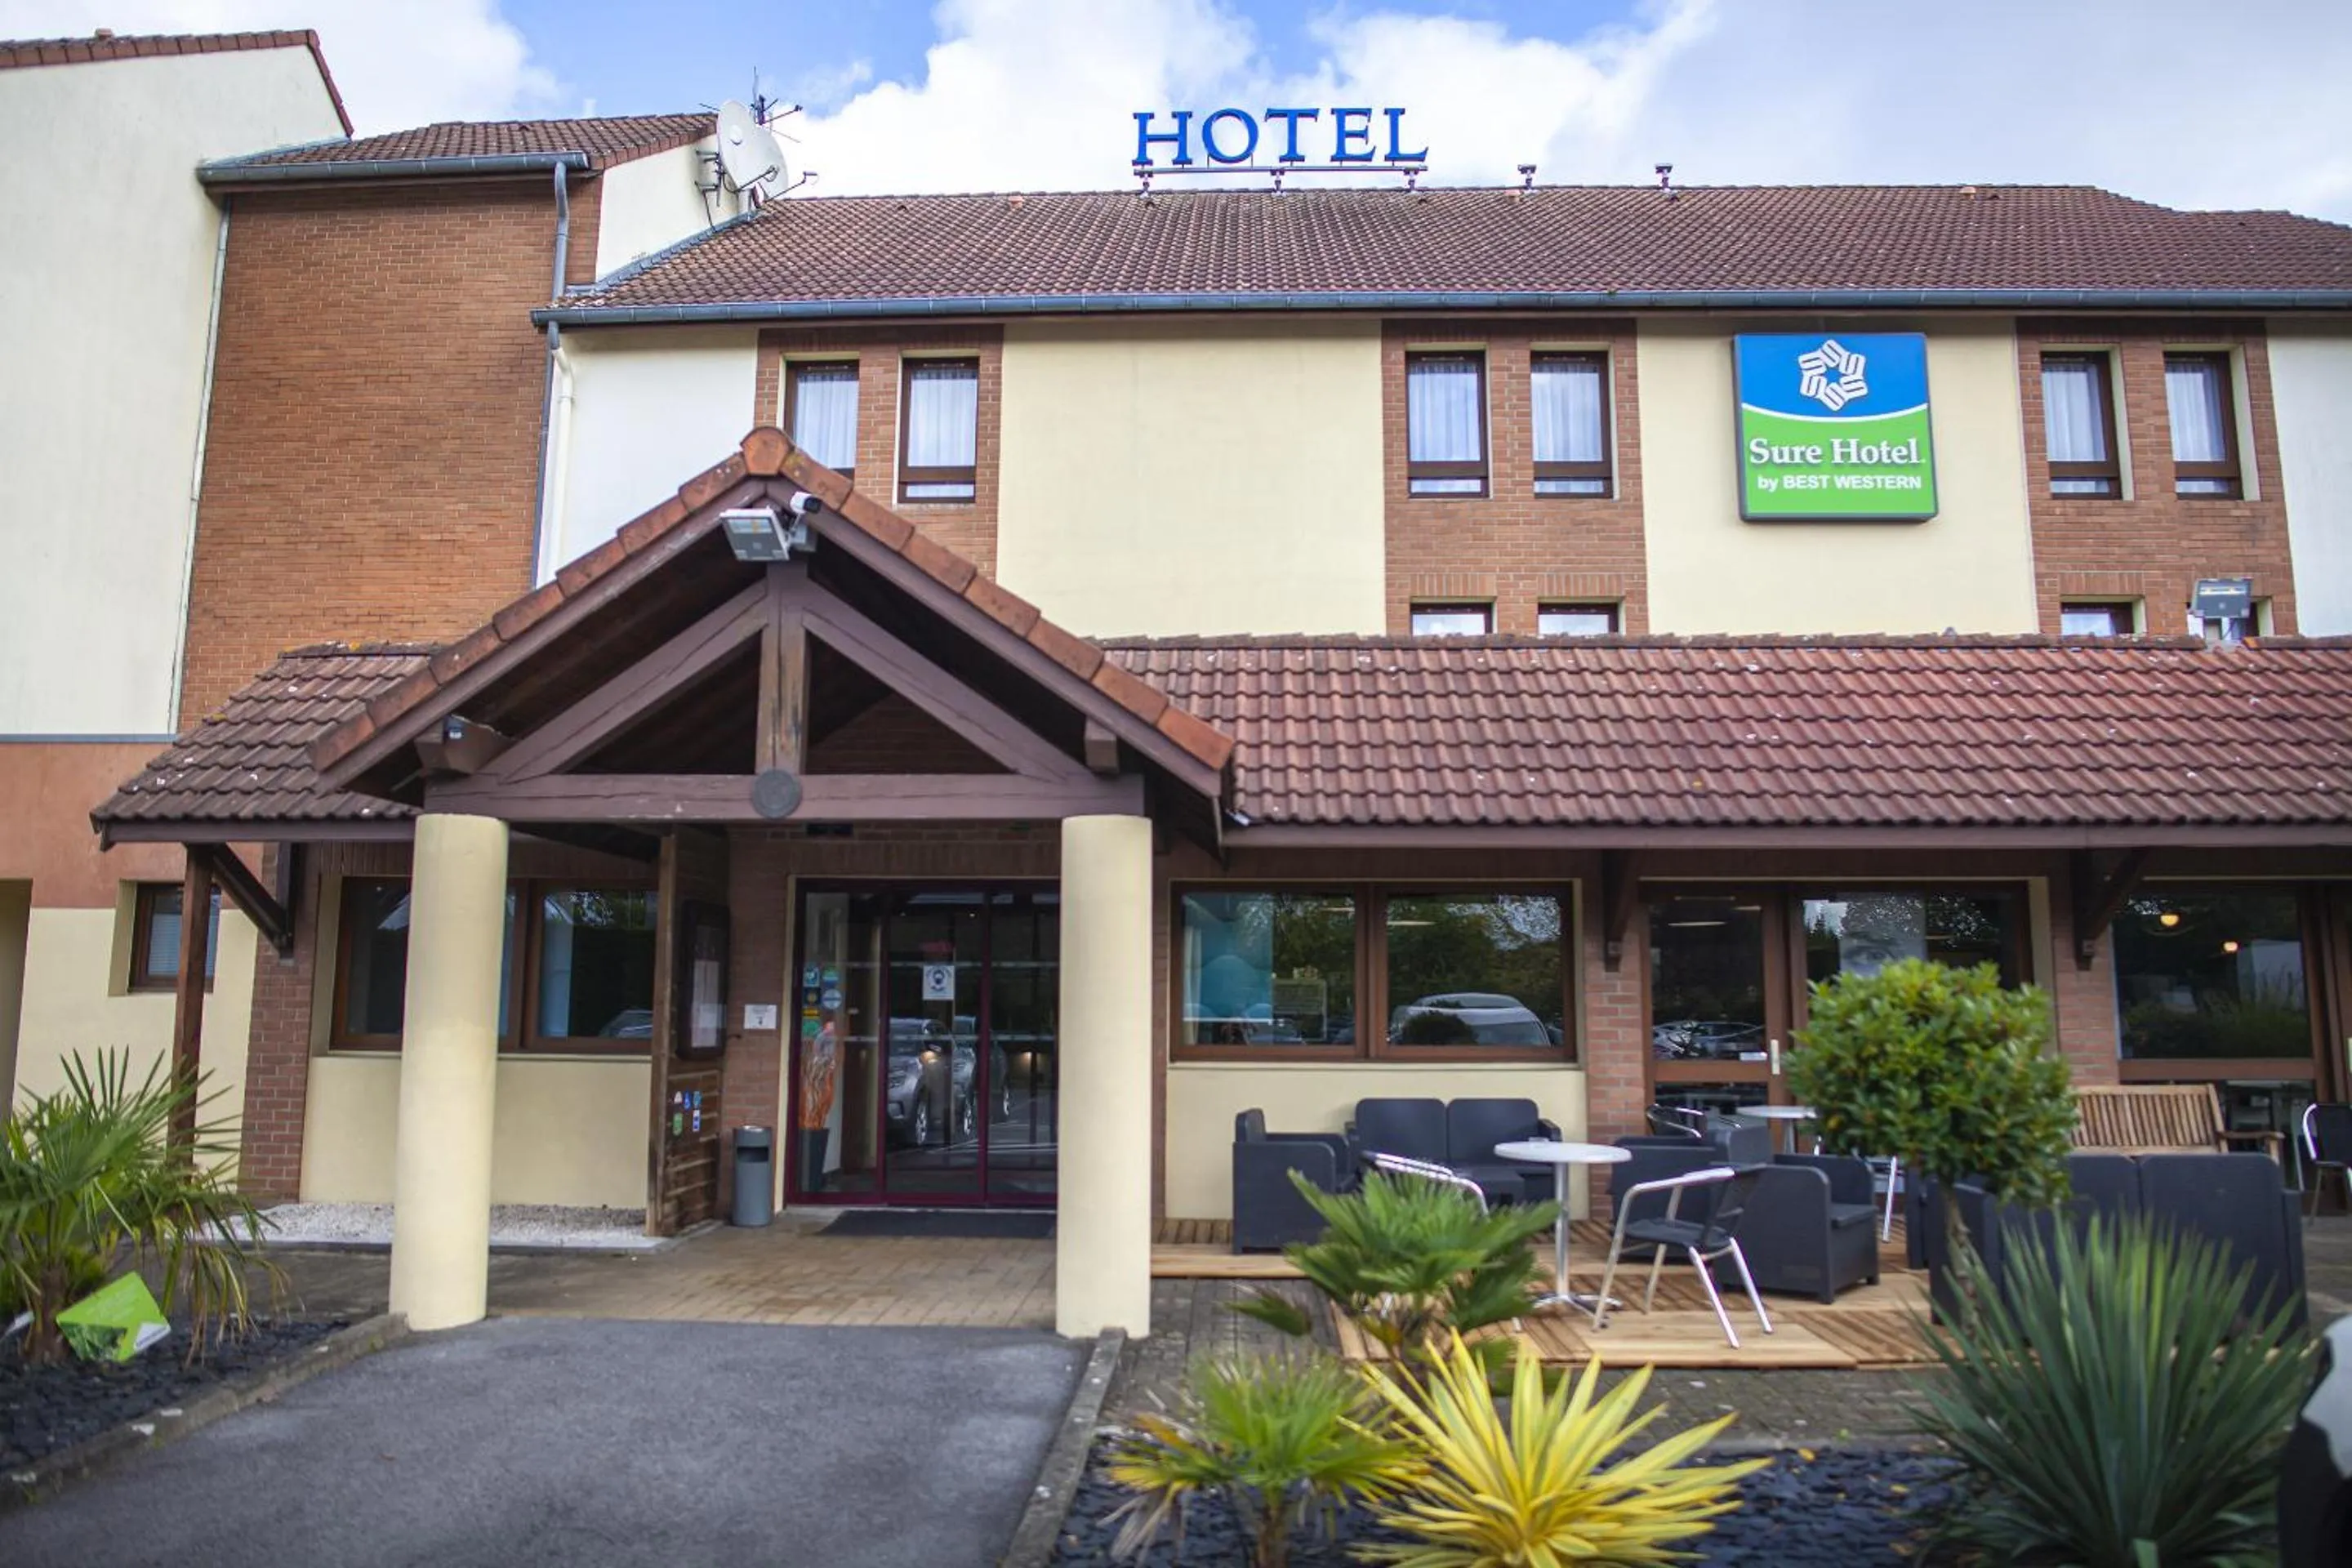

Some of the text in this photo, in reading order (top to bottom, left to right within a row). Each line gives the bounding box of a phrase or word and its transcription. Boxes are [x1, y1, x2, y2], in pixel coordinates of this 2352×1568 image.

[1132, 108, 1428, 166] HOTEL
[1749, 438, 1921, 464] Sure Hotel
[1757, 474, 1922, 492] by BEST WESTERN
